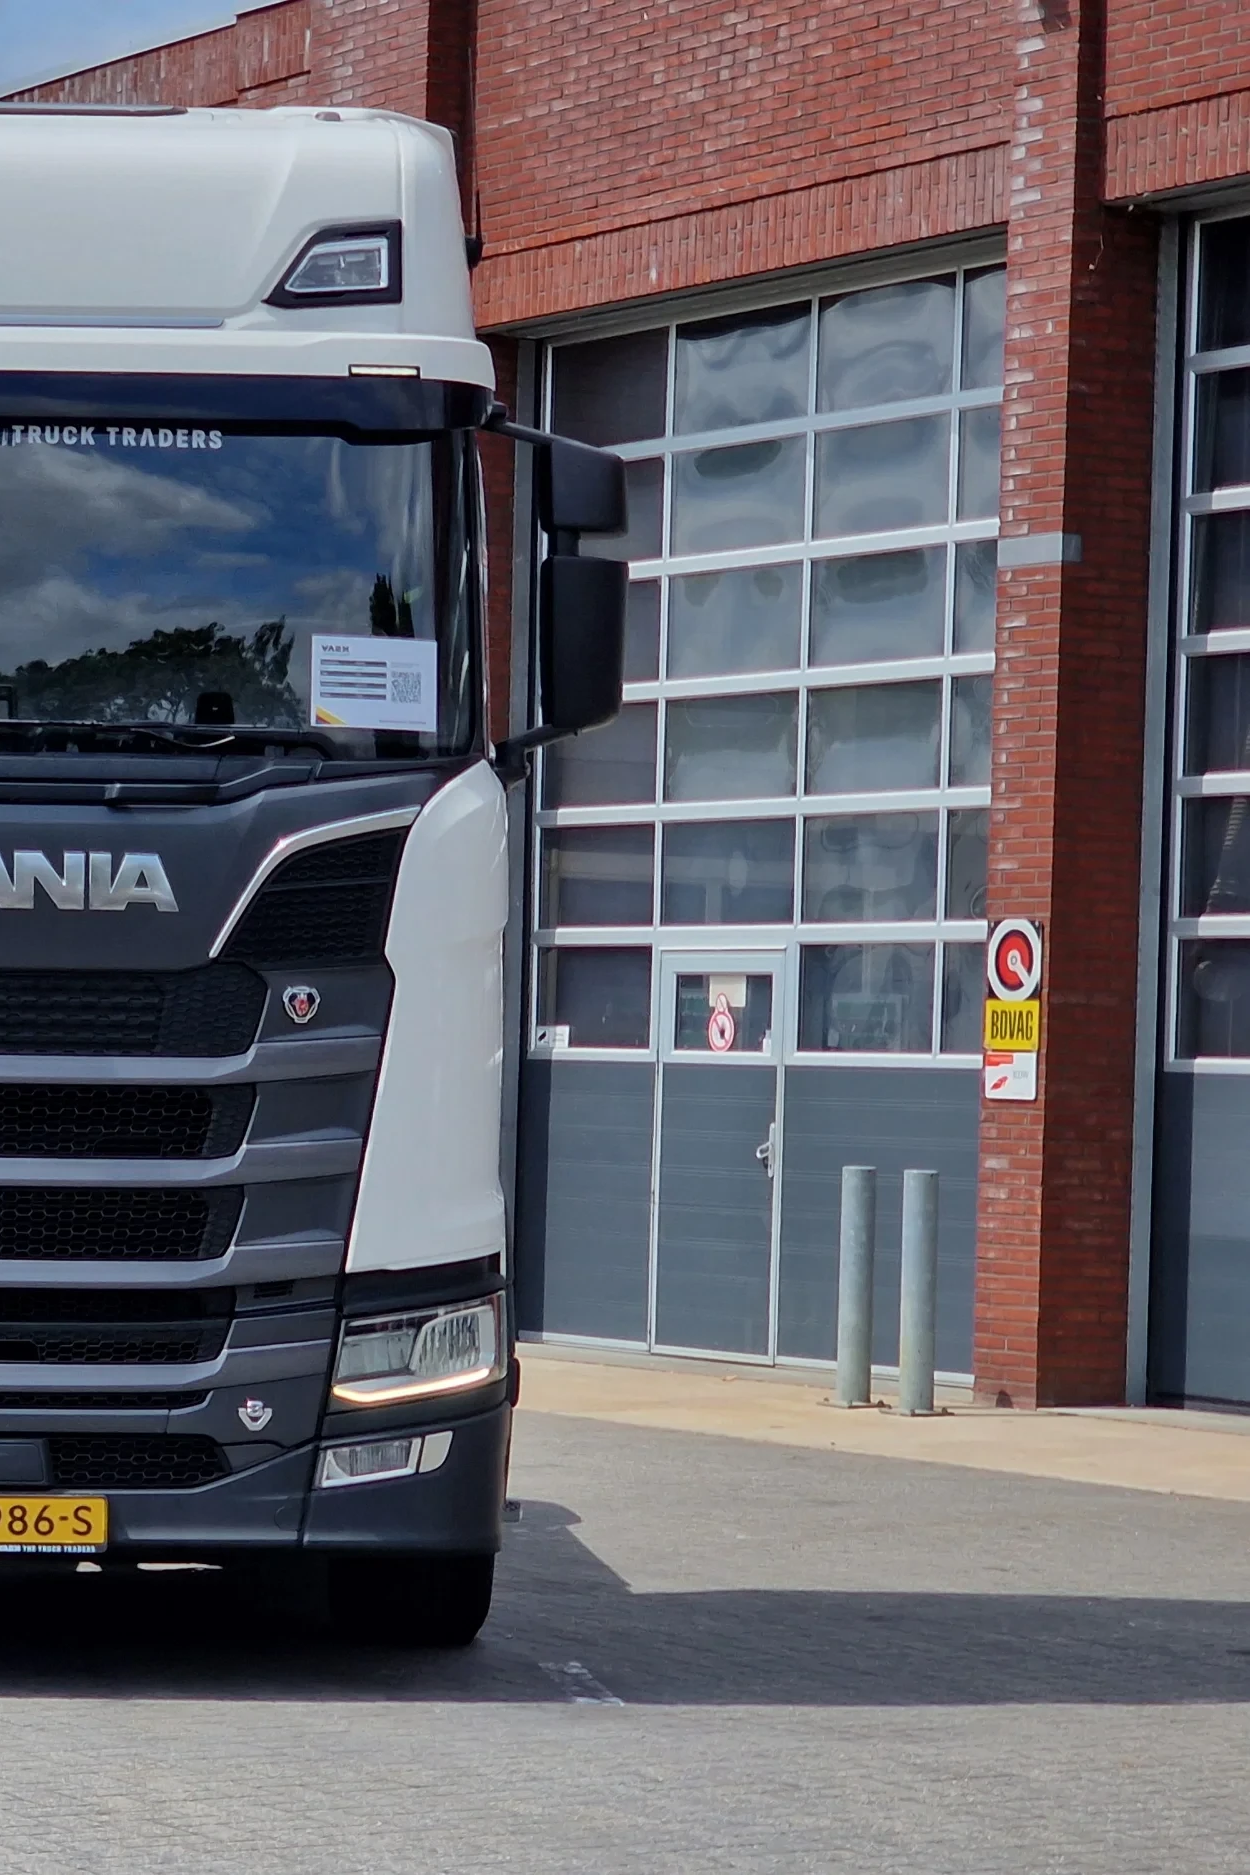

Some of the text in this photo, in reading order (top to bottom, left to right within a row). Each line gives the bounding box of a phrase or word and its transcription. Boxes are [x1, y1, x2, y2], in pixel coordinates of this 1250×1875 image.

[11, 425, 96, 446] TRUCK
[106, 427, 223, 449] TRADERS
[990, 1010, 1033, 1040] BOVAG
